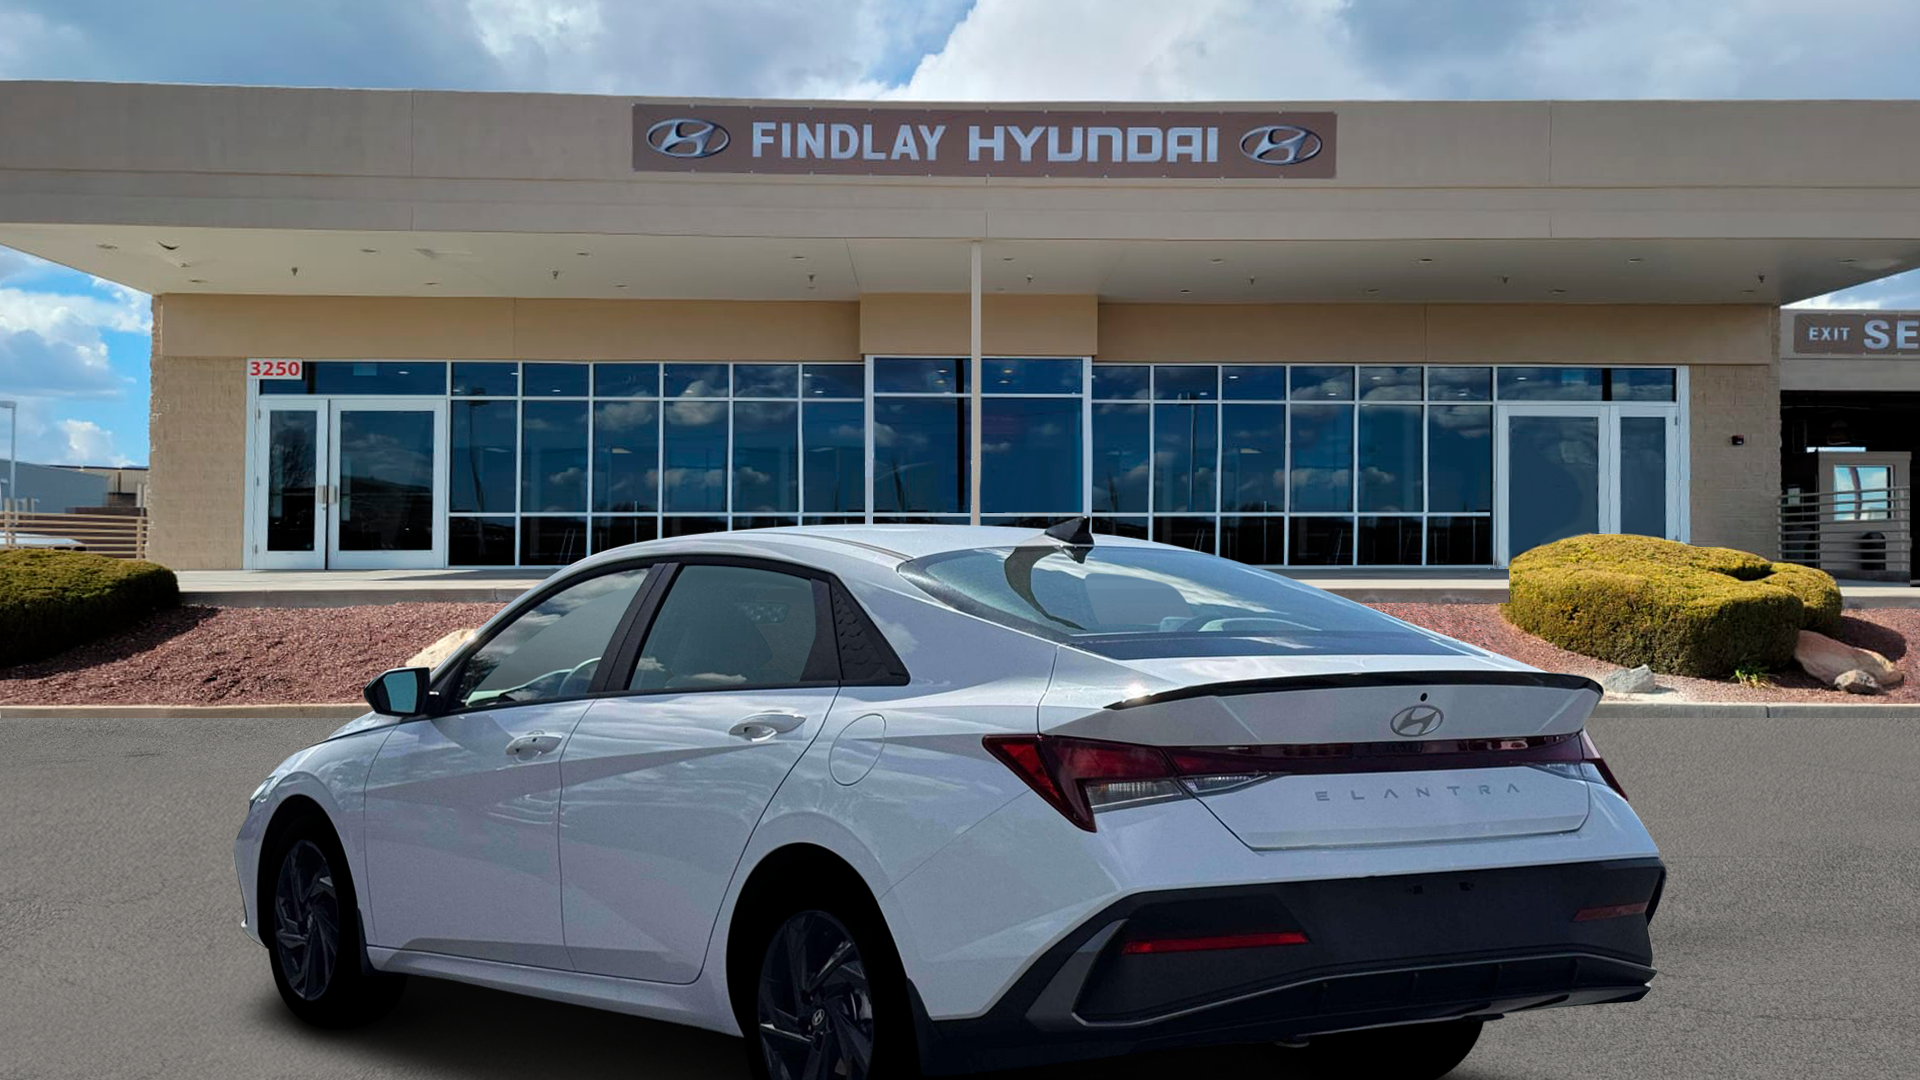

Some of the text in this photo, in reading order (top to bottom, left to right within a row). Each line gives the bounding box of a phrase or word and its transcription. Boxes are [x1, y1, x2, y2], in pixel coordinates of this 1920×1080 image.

[751, 121, 1219, 163] FINDLAY HYUNDAI
[1808, 319, 1920, 350] EXIT SE
[249, 361, 300, 376] 3250
[1315, 783, 1520, 801] ELANTRA
